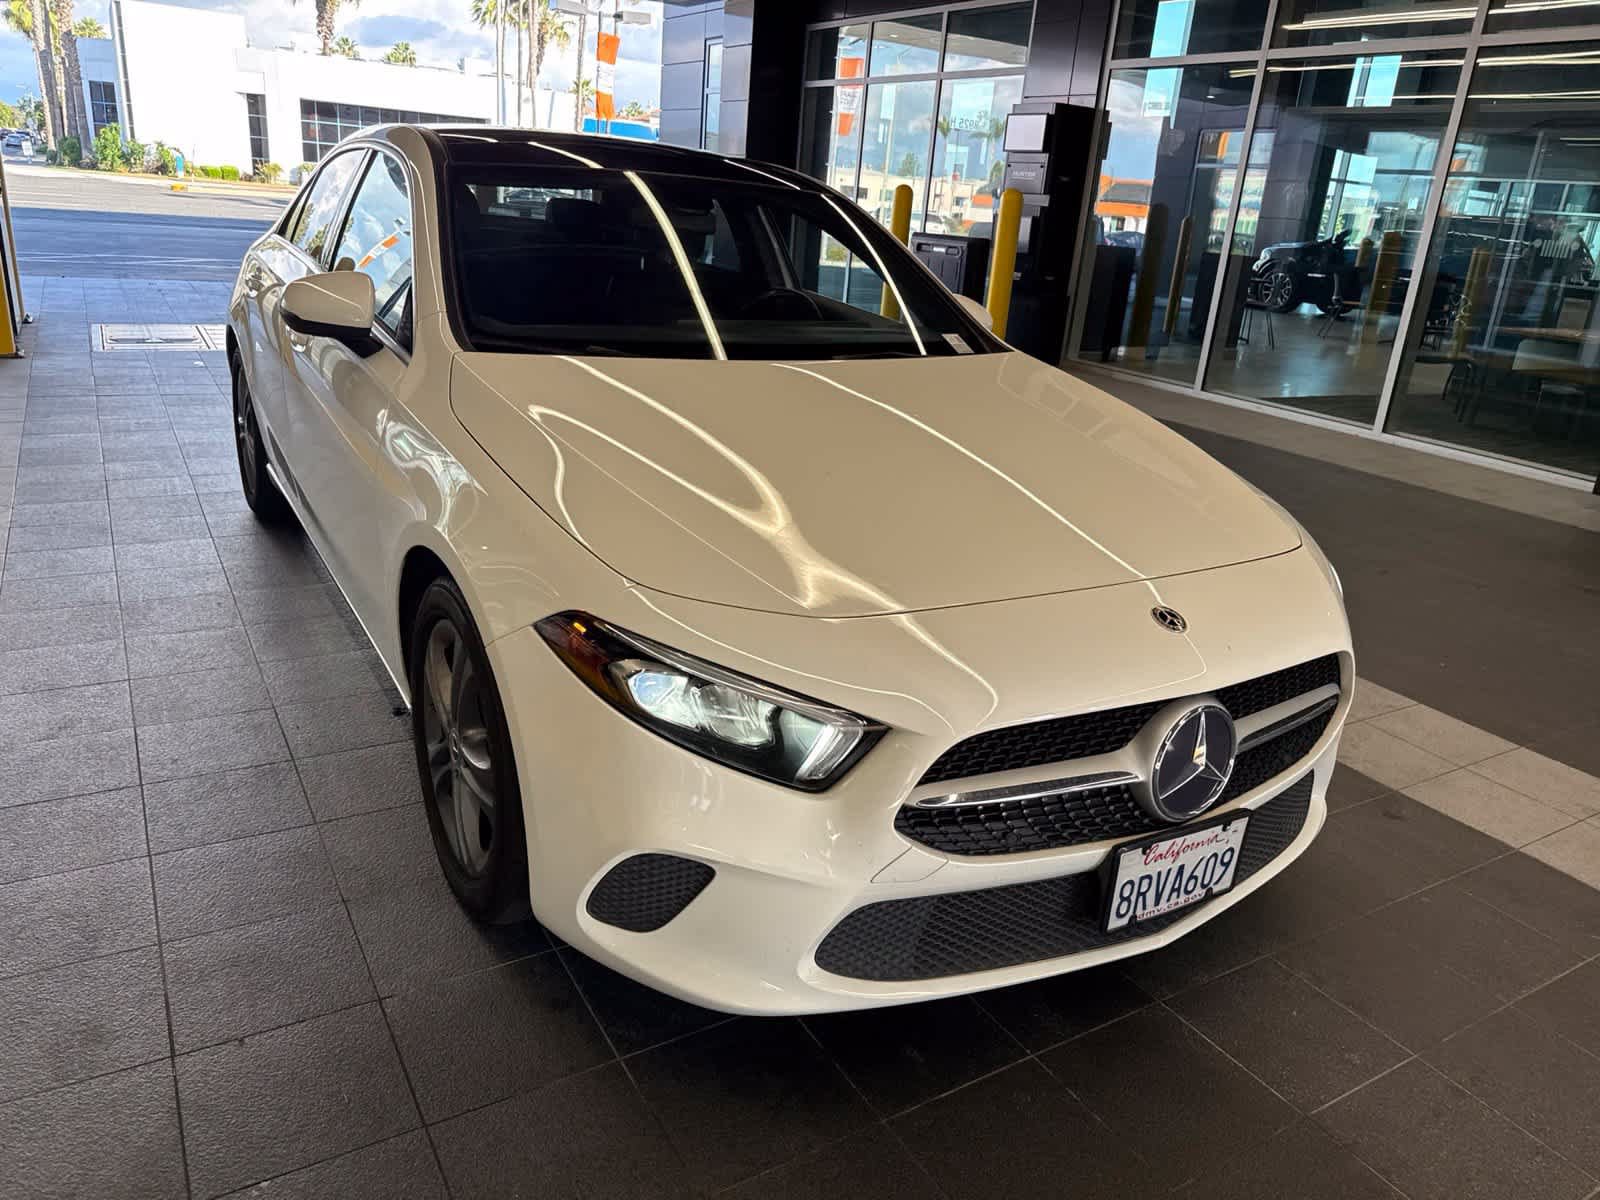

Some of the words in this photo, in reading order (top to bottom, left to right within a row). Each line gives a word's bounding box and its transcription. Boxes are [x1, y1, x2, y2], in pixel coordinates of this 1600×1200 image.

[1143, 831, 1225, 866] California
[1115, 846, 1235, 919] 8RVA609
[1136, 891, 1204, 921] dmv.ca.gov
